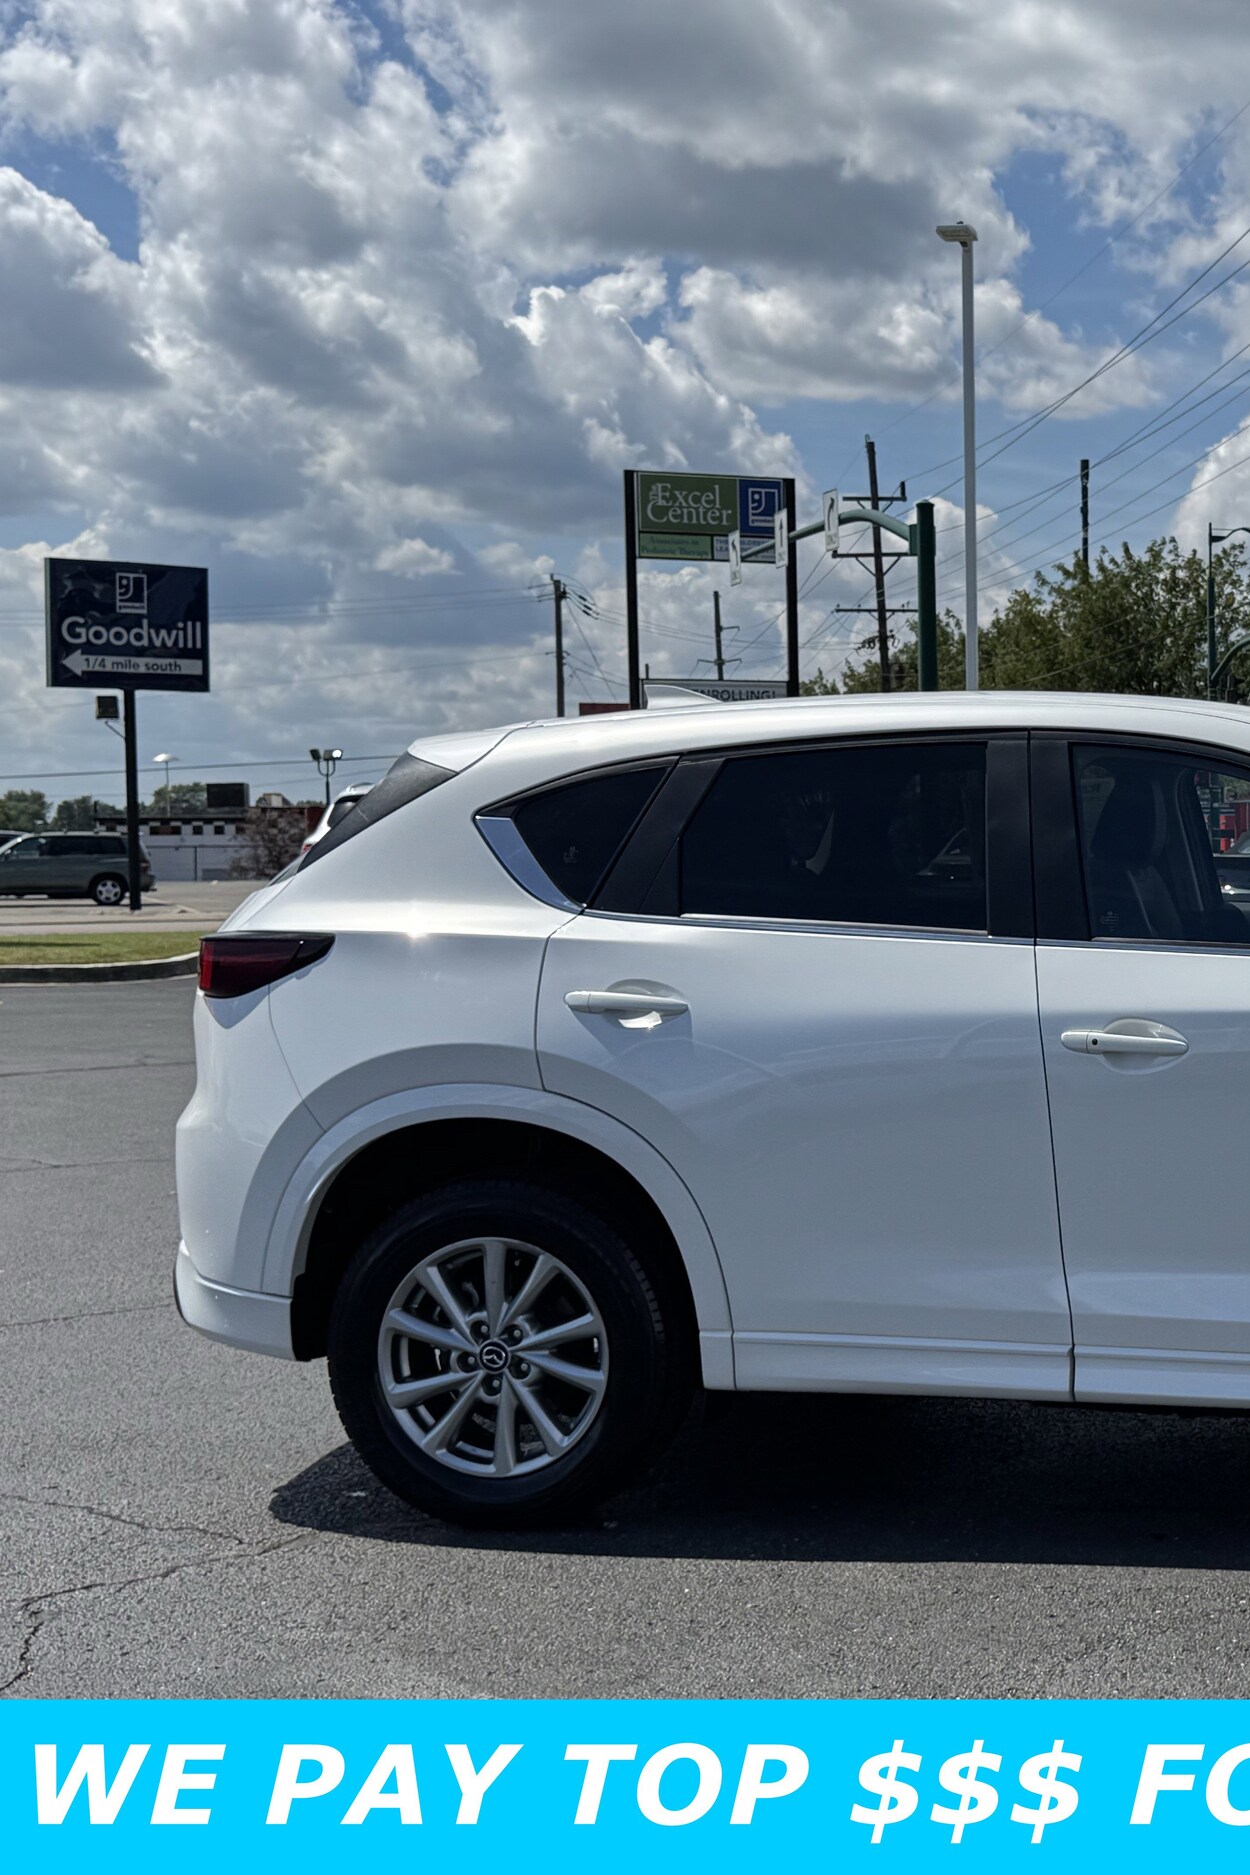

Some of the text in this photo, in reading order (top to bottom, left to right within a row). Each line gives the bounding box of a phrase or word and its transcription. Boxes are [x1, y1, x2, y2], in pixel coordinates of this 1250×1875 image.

[656, 483, 721, 508] Excel
[647, 500, 733, 525] Center
[61, 616, 202, 649] Goodwill
[84, 658, 182, 672] 1/4 mile south
[693, 689, 776, 702] NROLLING!
